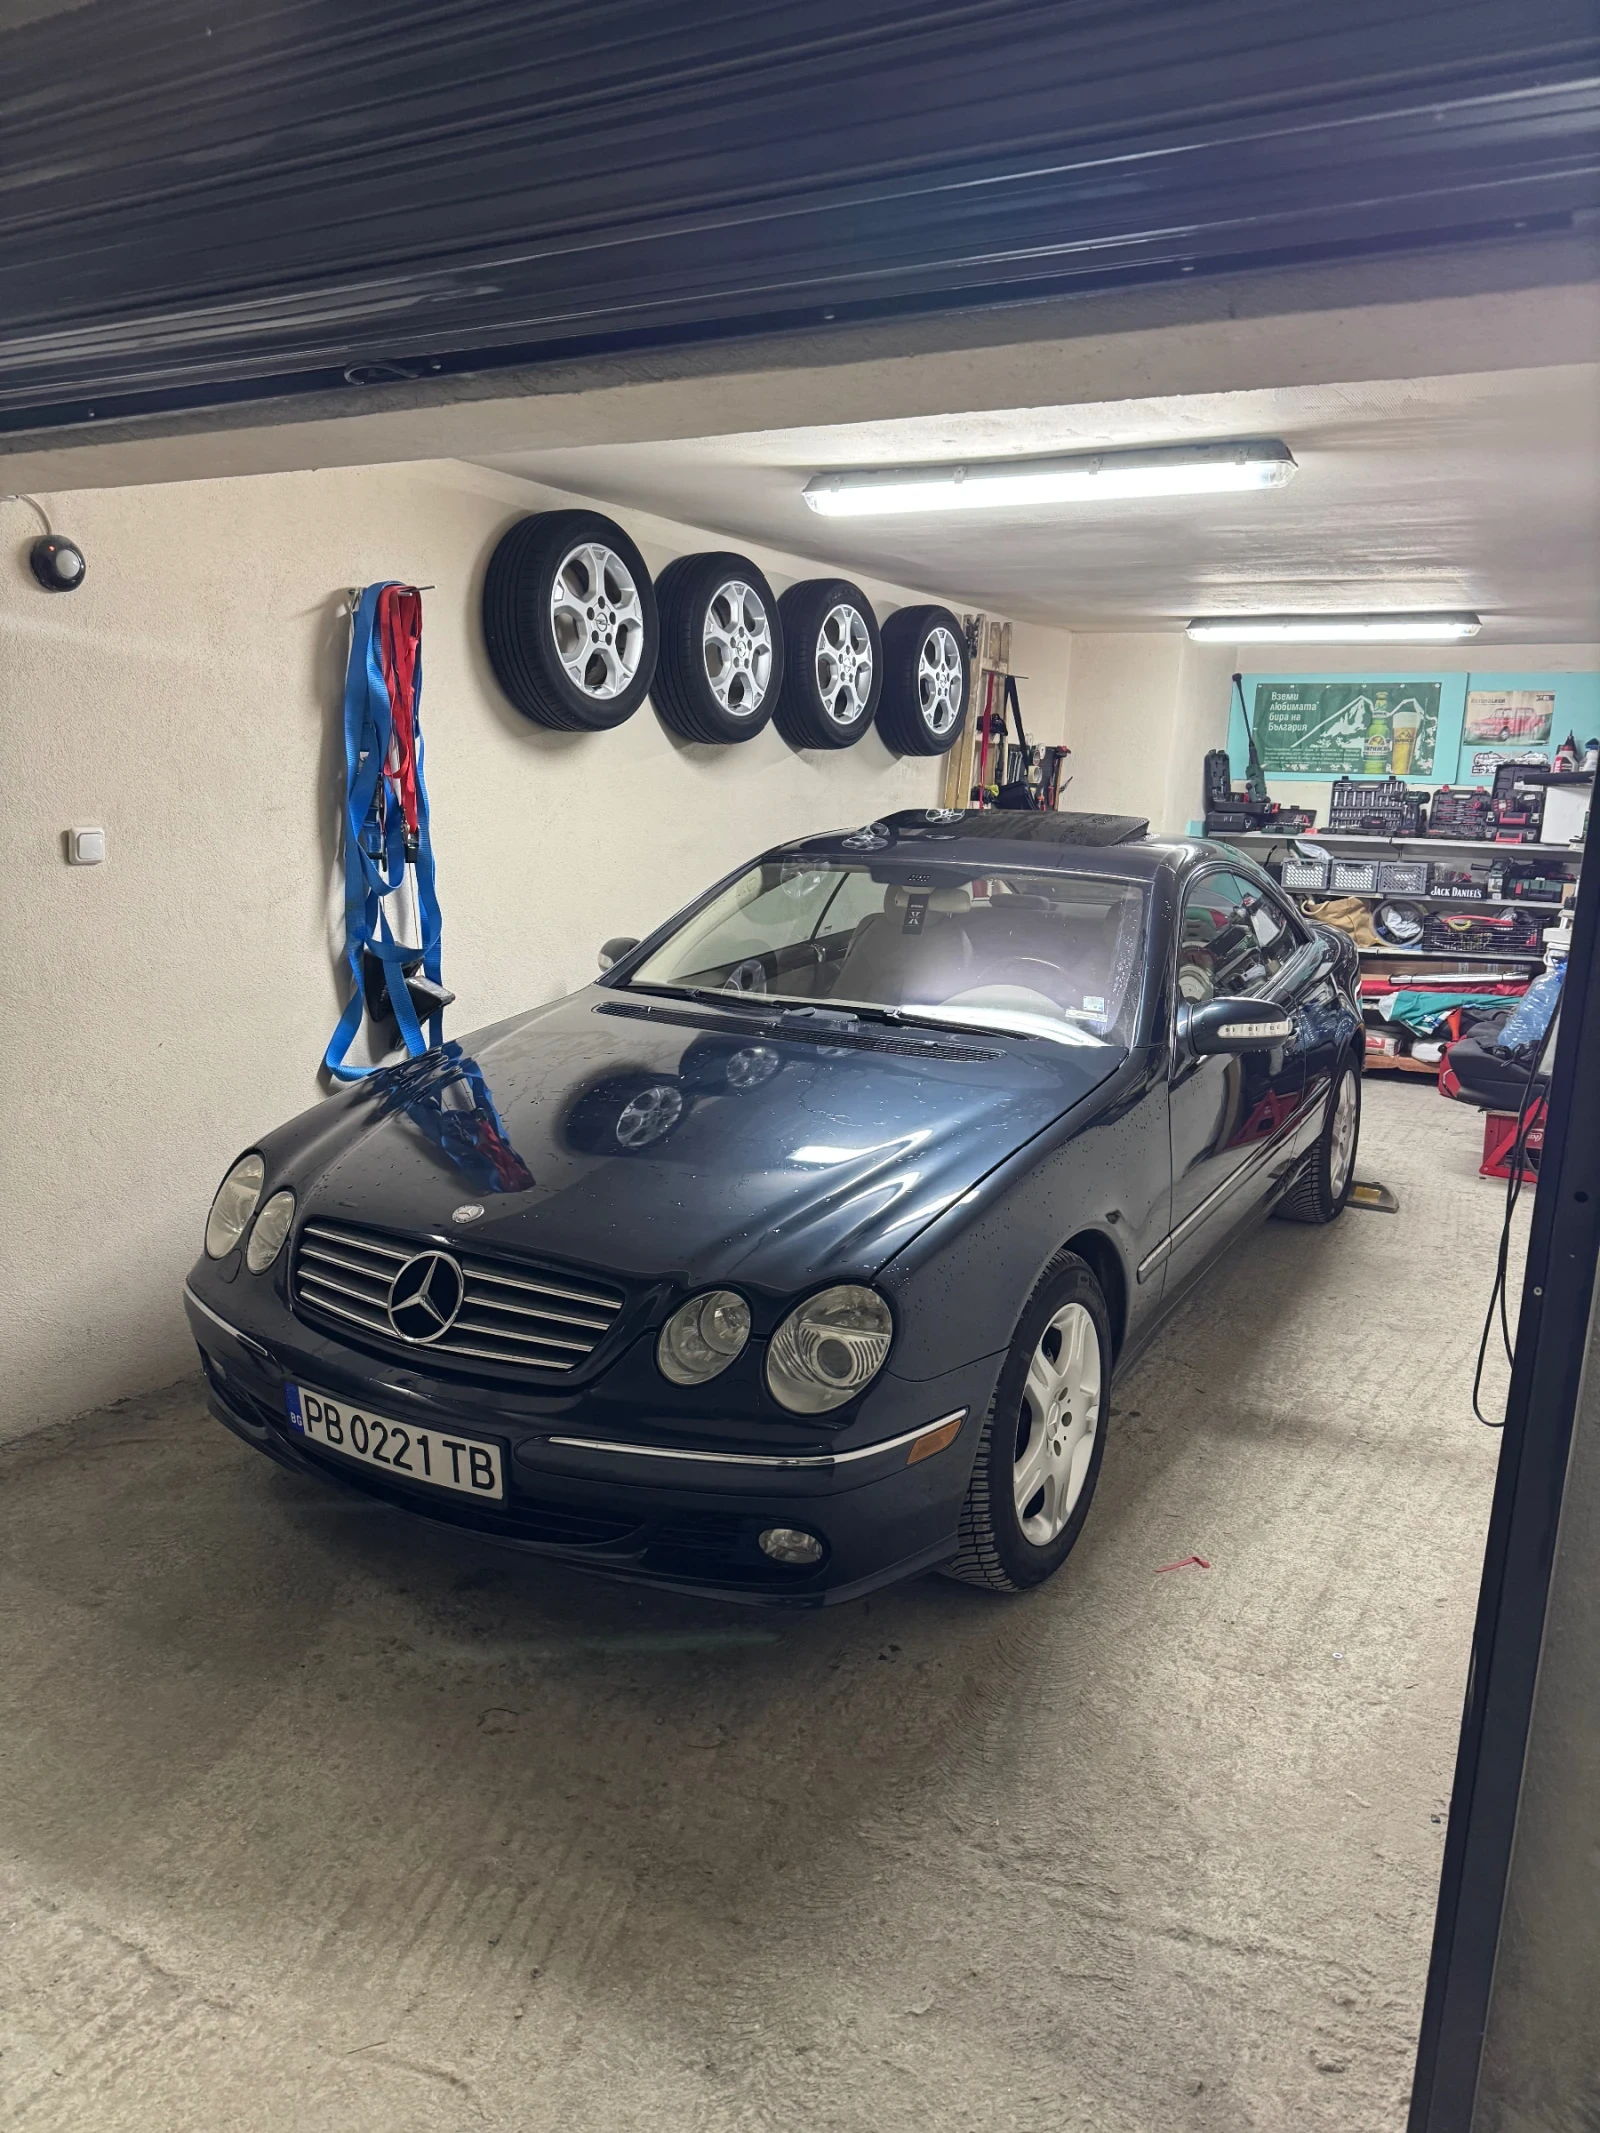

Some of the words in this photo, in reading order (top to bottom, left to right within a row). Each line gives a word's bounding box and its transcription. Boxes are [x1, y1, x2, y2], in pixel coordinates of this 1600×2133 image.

[1271, 691, 1299, 701] Вземи
[1269, 712, 1289, 723] бира
[1291, 713, 1301, 721] на
[1268, 722, 1308, 733] България
[1430, 886, 1451, 897] JACK
[290, 1411, 303, 1427] BG
[303, 1394, 344, 1445] PB
[350, 1414, 431, 1477] 0221
[442, 1439, 496, 1490] TB
